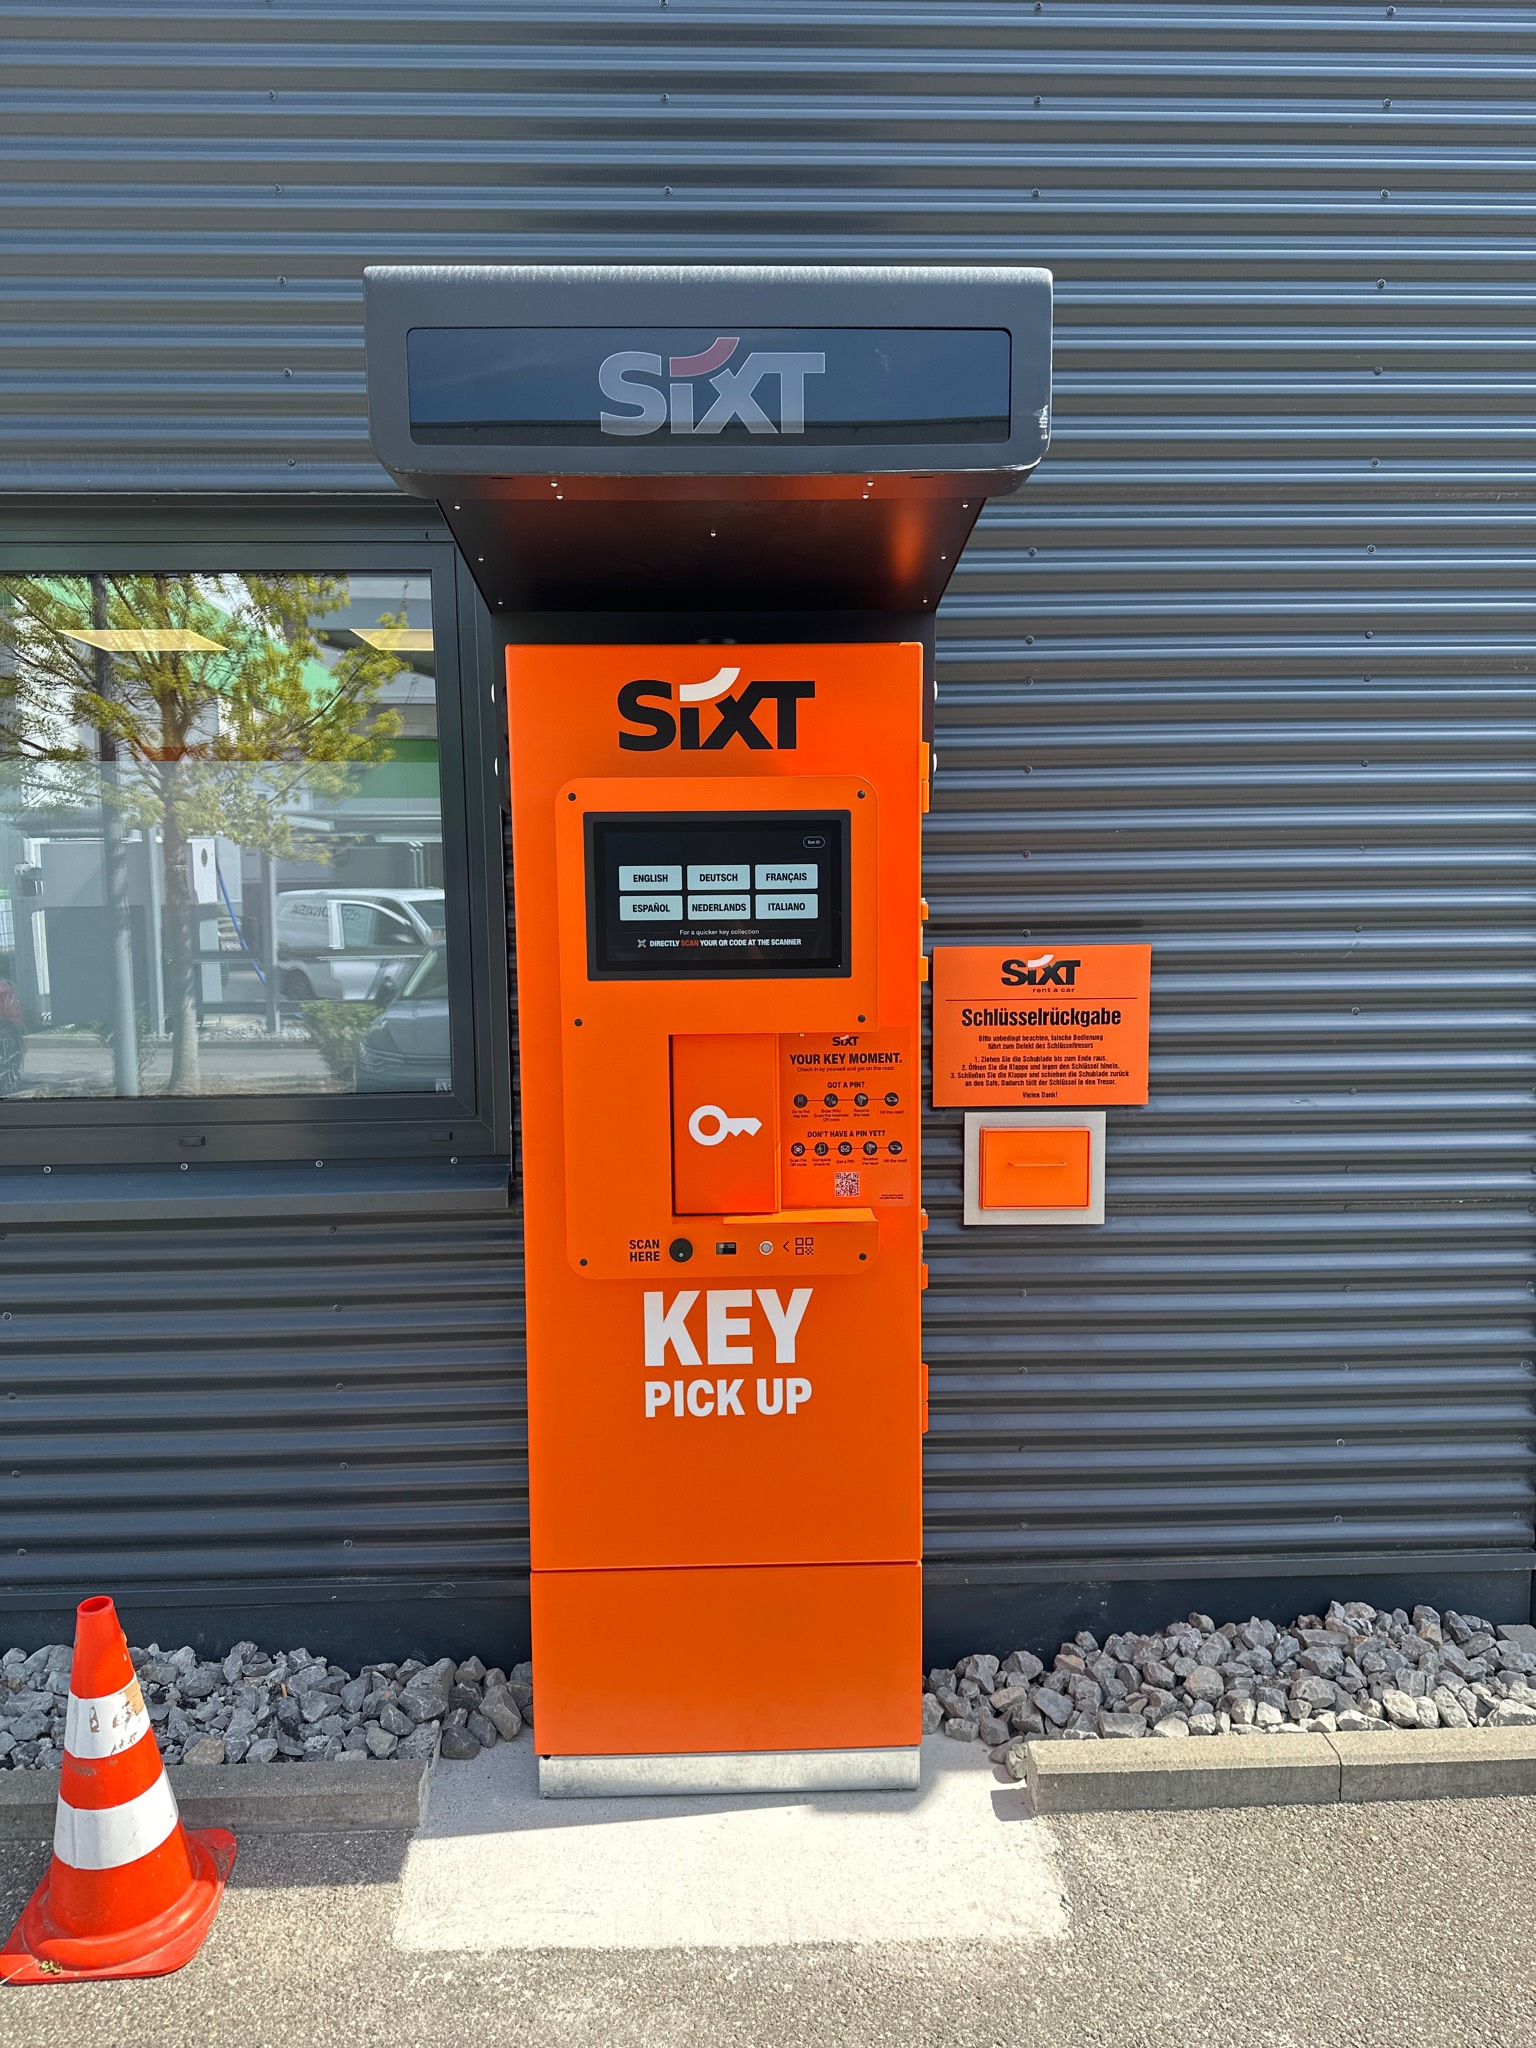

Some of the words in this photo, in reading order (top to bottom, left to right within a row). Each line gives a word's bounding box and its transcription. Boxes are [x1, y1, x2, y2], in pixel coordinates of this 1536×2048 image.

[633, 874, 668, 882] ENGLISH
[699, 873, 738, 882] DEUTSCH
[766, 872, 807, 883] FRANÇAIS
[632, 902, 670, 912] ESPAÑOL
[692, 903, 746, 912] NEDERLANDS
[768, 902, 805, 911] ITALIANO
[962, 1007, 1121, 1027] Schlüsselrückgabe
[790, 1054, 820, 1065] YOUR
[824, 1054, 846, 1064] KEY
[849, 1053, 902, 1063] MOMENT.
[630, 1240, 660, 1249] SCAN
[630, 1252, 660, 1262] HERE
[644, 1288, 813, 1367] KEY
[645, 1379, 745, 1418] PICK
[756, 1378, 812, 1415] UP
